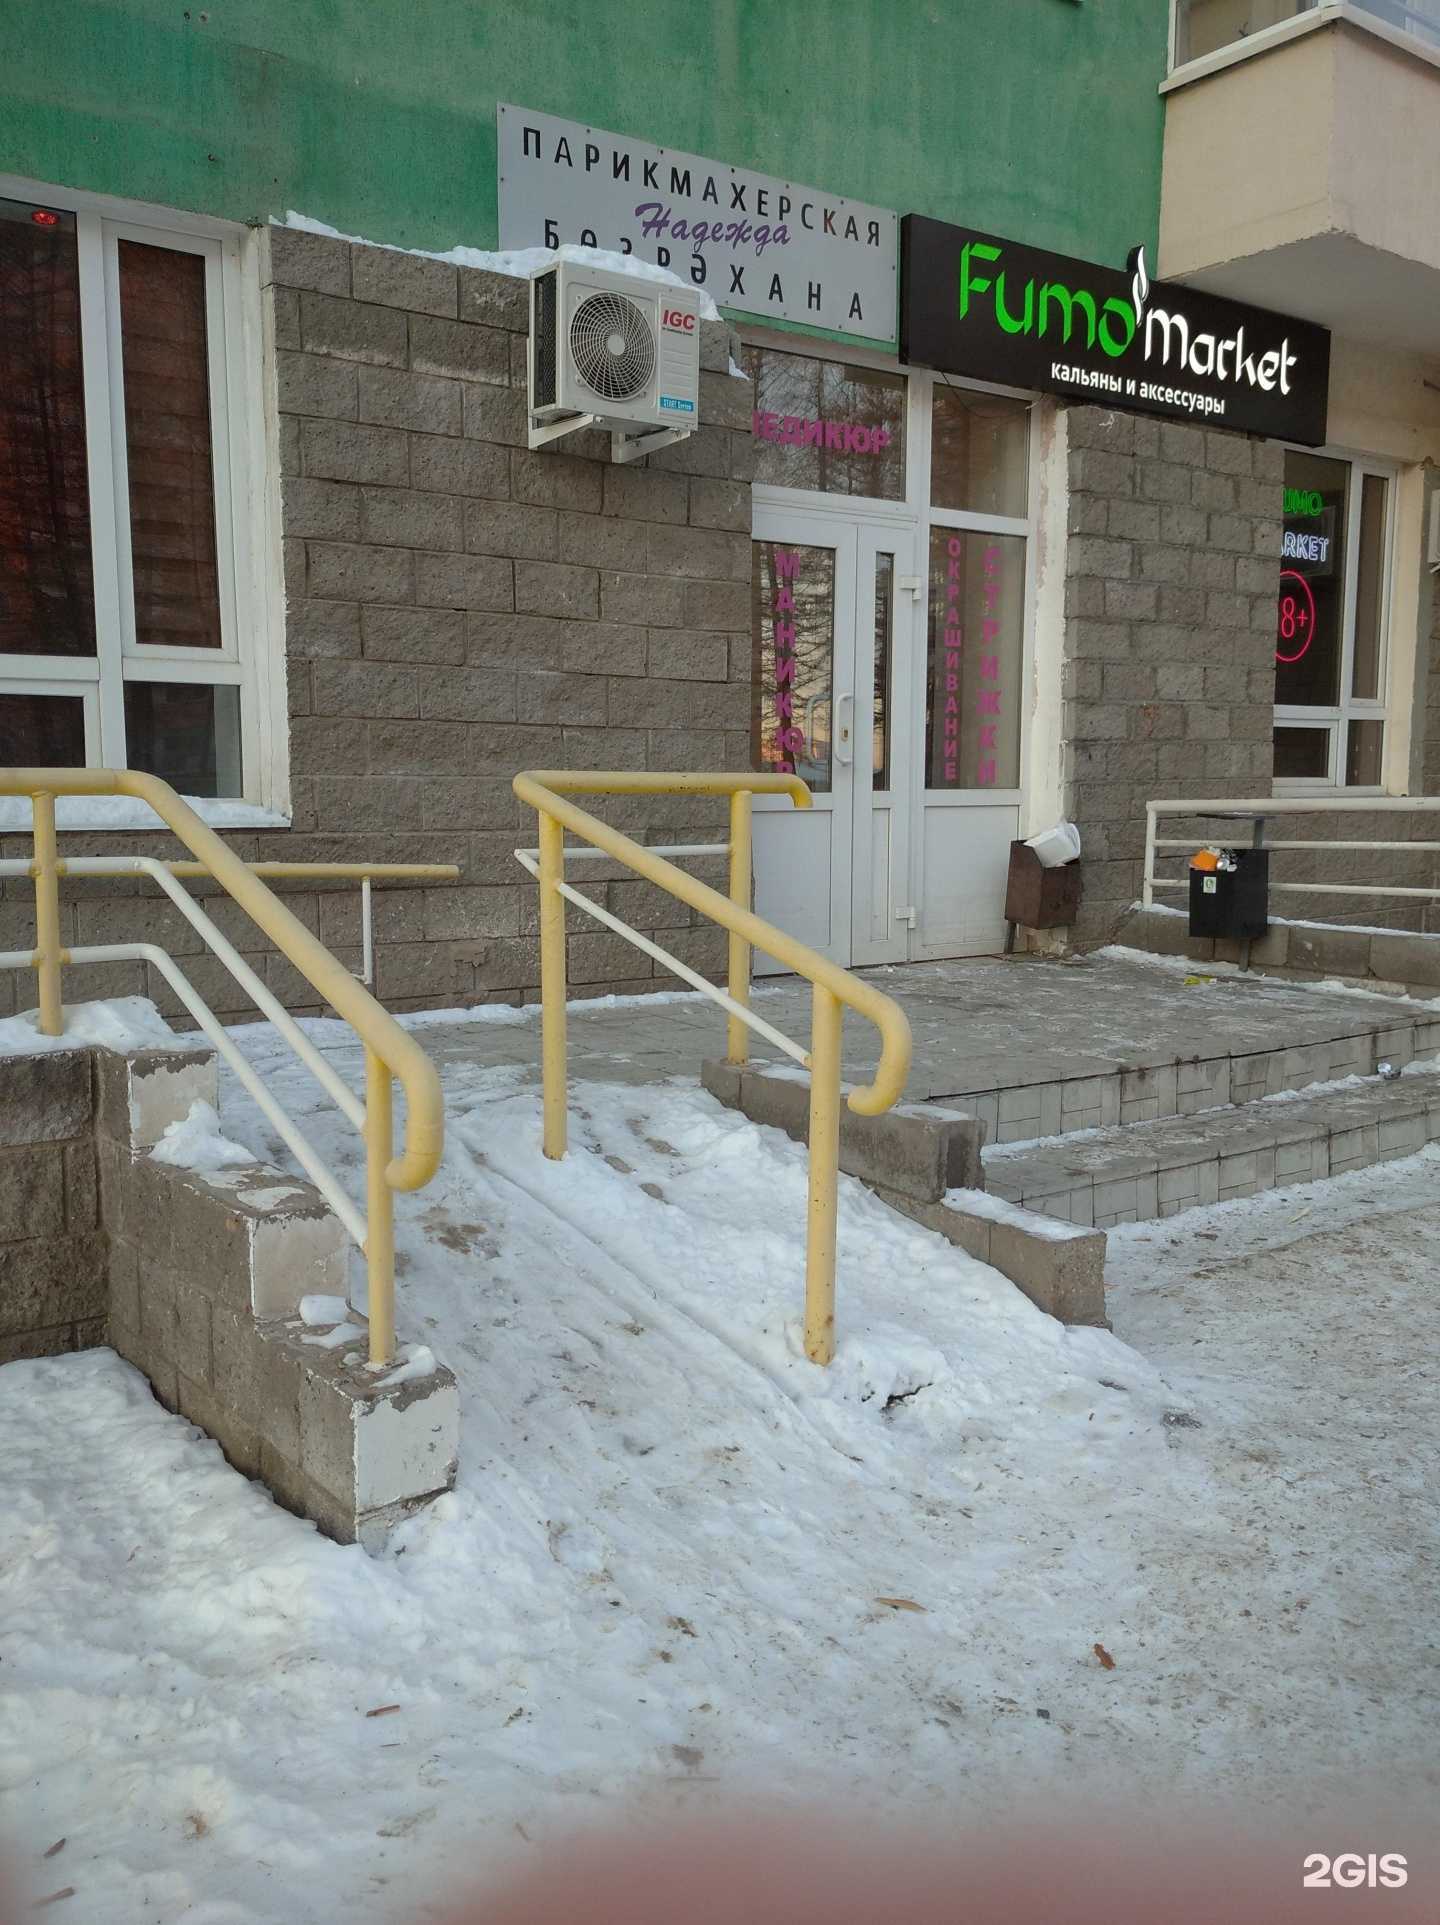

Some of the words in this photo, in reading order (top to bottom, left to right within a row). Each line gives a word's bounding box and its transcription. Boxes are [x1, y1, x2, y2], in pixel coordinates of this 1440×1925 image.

[522, 126, 881, 247] ПАРИКМАХЕРСКАЯ
[634, 202, 792, 257] Надежда
[662, 309, 696, 330] IGC
[1051, 362, 1122, 393] кальяны
[1126, 378, 1136, 395] и
[1139, 379, 1225, 415] аксессуары
[944, 538, 962, 781] ОКРАШИВАНИЕ
[976, 546, 1002, 785] СТРИЖКИ
